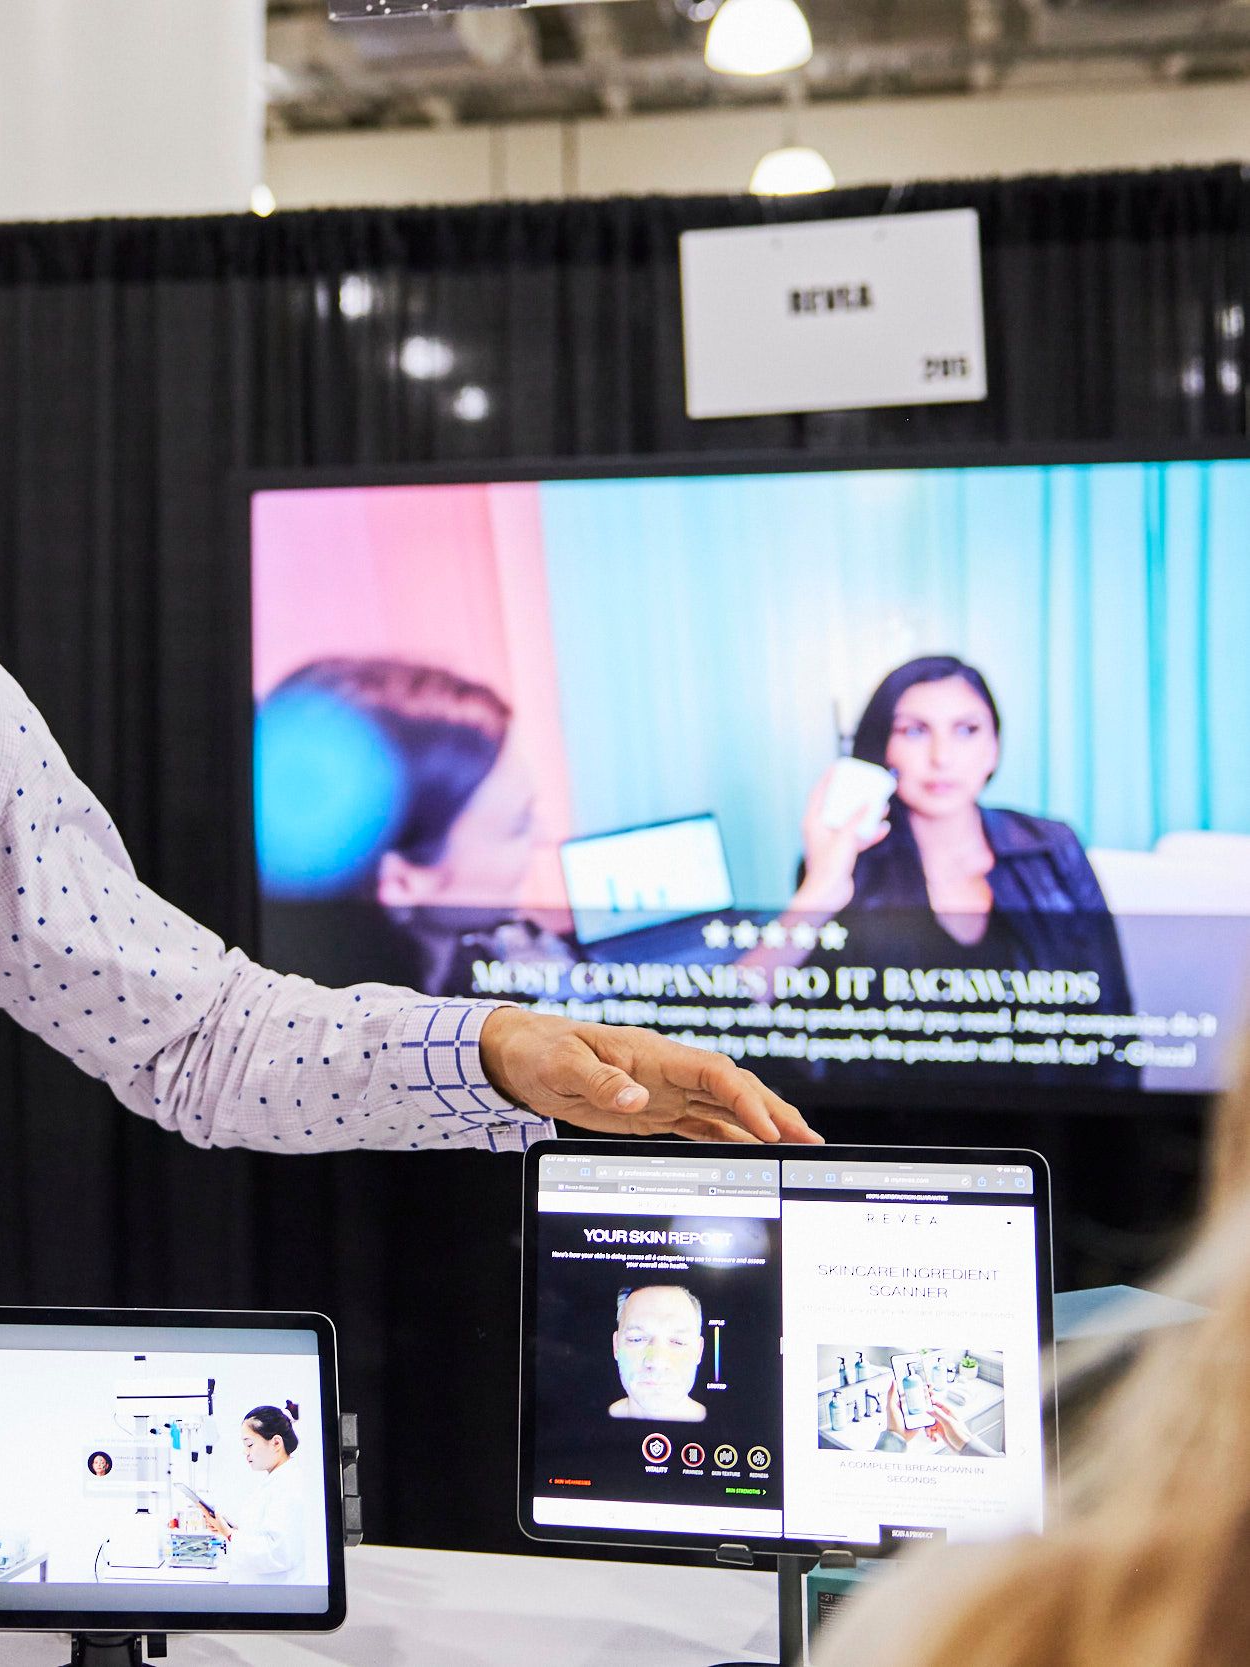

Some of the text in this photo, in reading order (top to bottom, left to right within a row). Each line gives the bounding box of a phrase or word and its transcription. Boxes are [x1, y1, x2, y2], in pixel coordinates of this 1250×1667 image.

[472, 960, 1100, 1004] MOST COMPANIES DO IT BACKWARDS
[867, 1213, 938, 1225] REVEA
[583, 1228, 628, 1242] YOUR
[629, 1230, 667, 1244] SKIN
[818, 1264, 999, 1280] SKINCARE INGREDIENT
[869, 1284, 948, 1298] SCANNER
[849, 1461, 902, 1471] COMPLETE
[905, 1464, 972, 1474] BREAKDOWN
[886, 1475, 937, 1485] SECONDS
